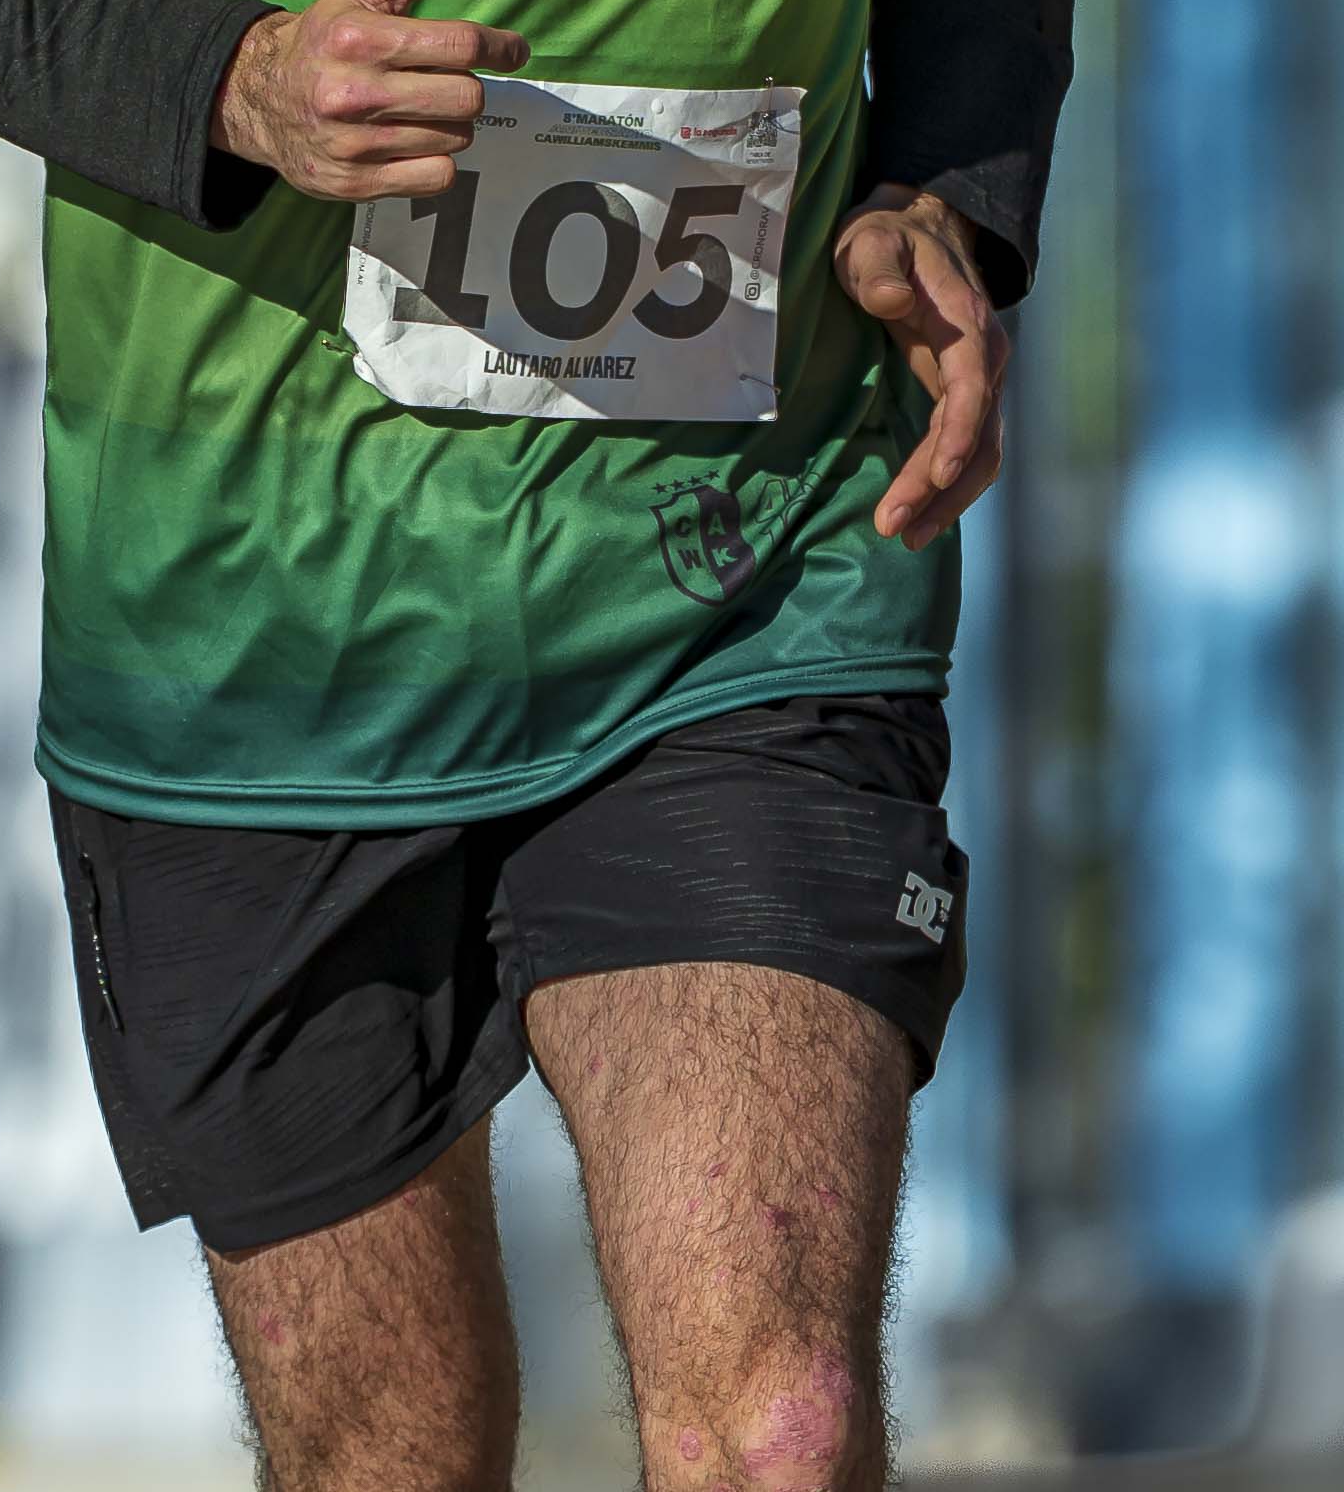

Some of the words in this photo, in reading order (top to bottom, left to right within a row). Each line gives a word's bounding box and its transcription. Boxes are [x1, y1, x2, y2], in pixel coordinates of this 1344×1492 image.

[392, 169, 746, 341] 105
[483, 350, 562, 379] LAUTARO
[563, 355, 637, 380] ALVAREZ
